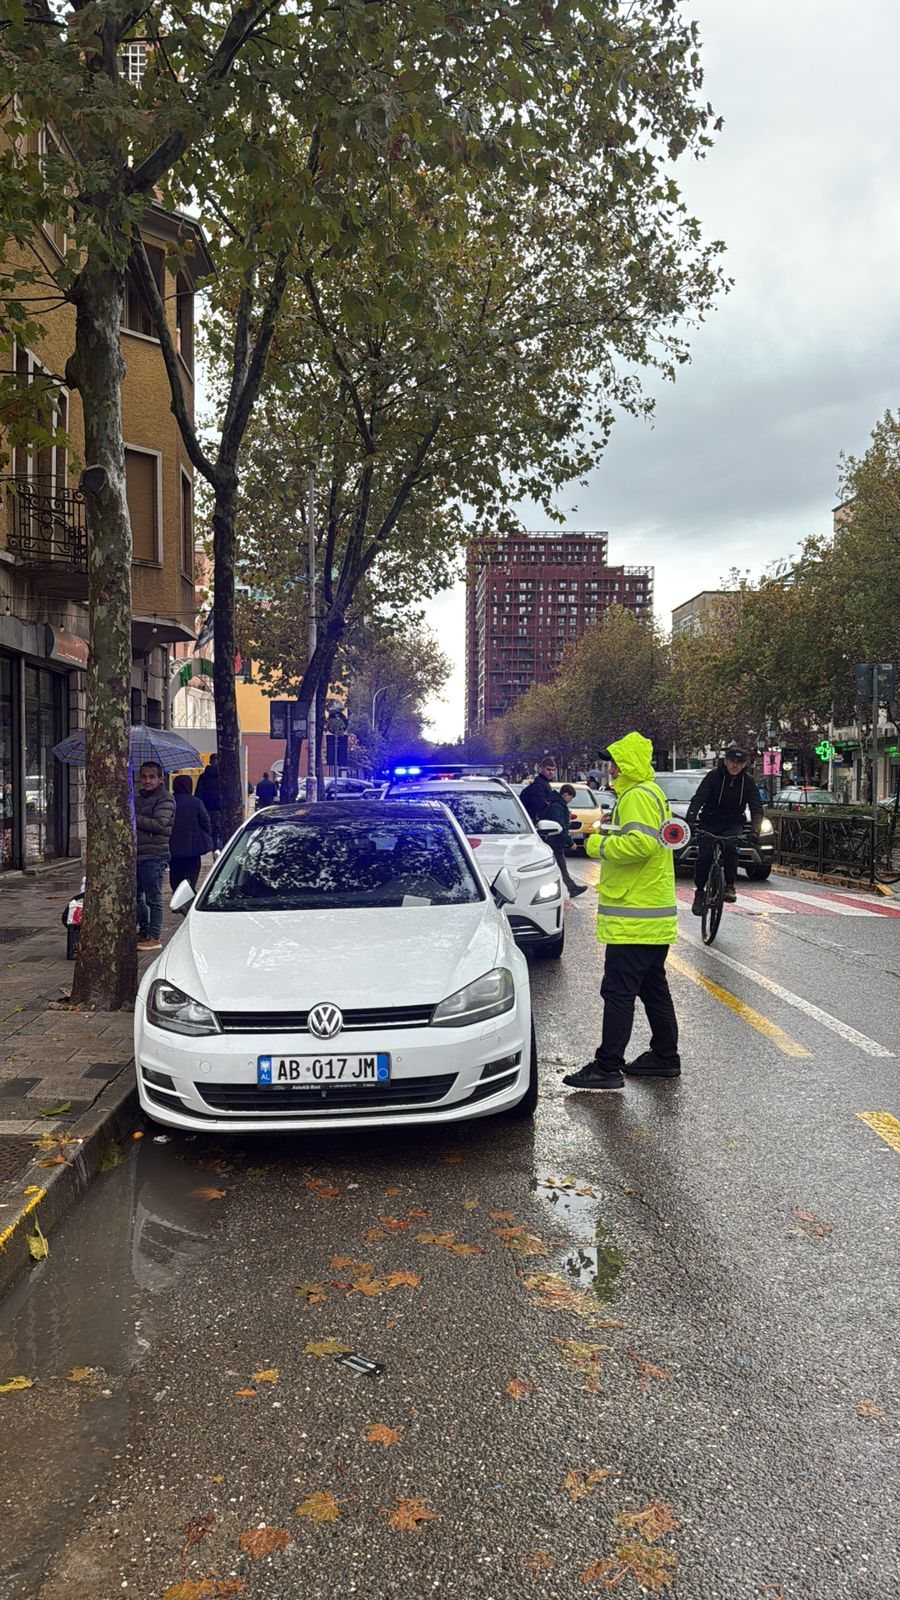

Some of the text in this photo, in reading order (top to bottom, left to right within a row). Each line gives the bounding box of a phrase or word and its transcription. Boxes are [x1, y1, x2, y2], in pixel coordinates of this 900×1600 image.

[278, 1058, 375, 1080] AB 017 JM
